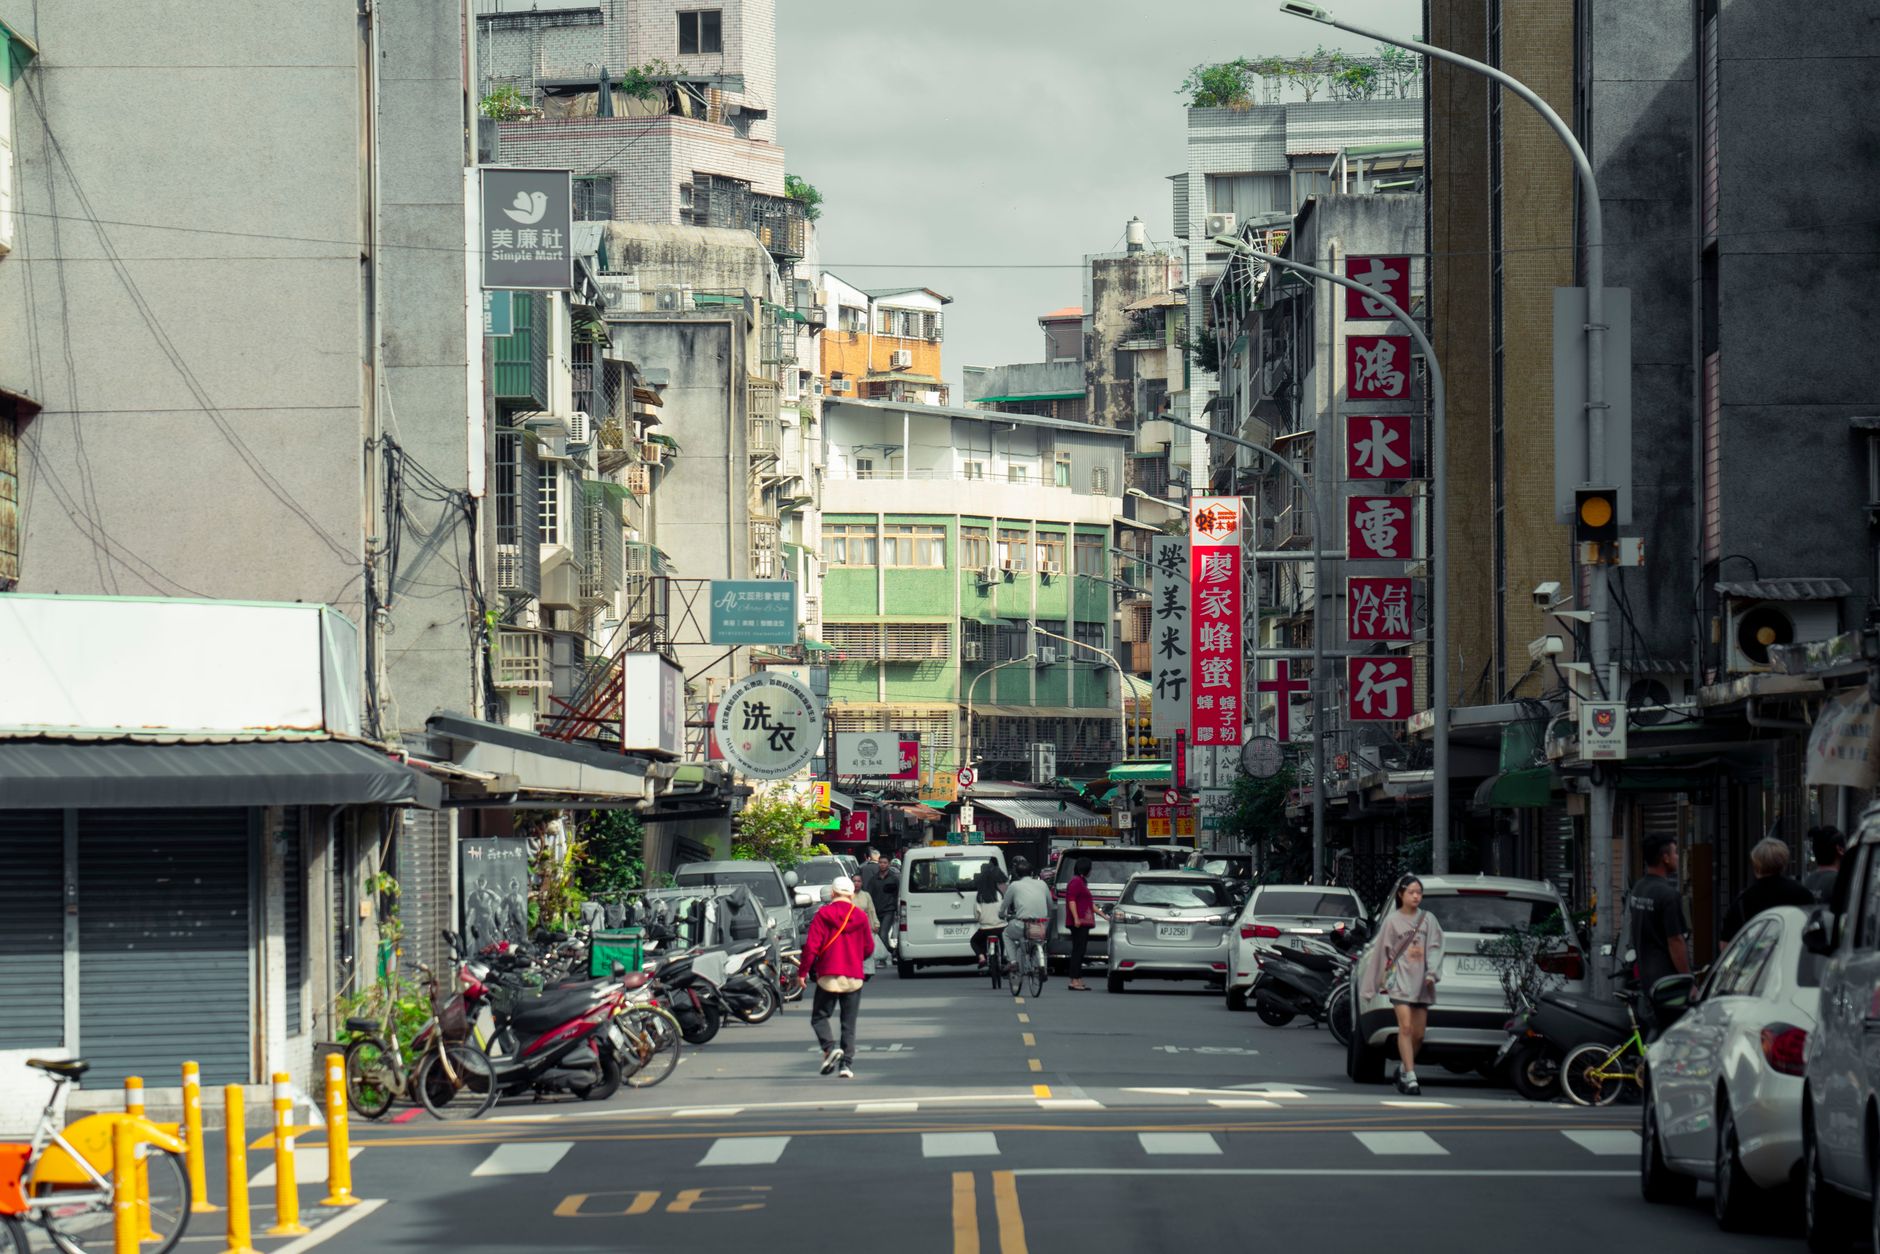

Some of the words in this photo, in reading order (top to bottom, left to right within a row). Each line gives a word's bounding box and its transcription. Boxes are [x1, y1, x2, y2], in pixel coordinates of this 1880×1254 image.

[491, 228, 564, 249] 美廉社
[491, 250, 533, 263] Simple
[535, 250, 564, 261] Mart
[1156, 543, 1187, 702] 榮美米行
[1199, 551, 1234, 689] 廖家蜂蜜
[742, 700, 796, 752] 洗衣
[1219, 695, 1237, 742] 蜂子粉
